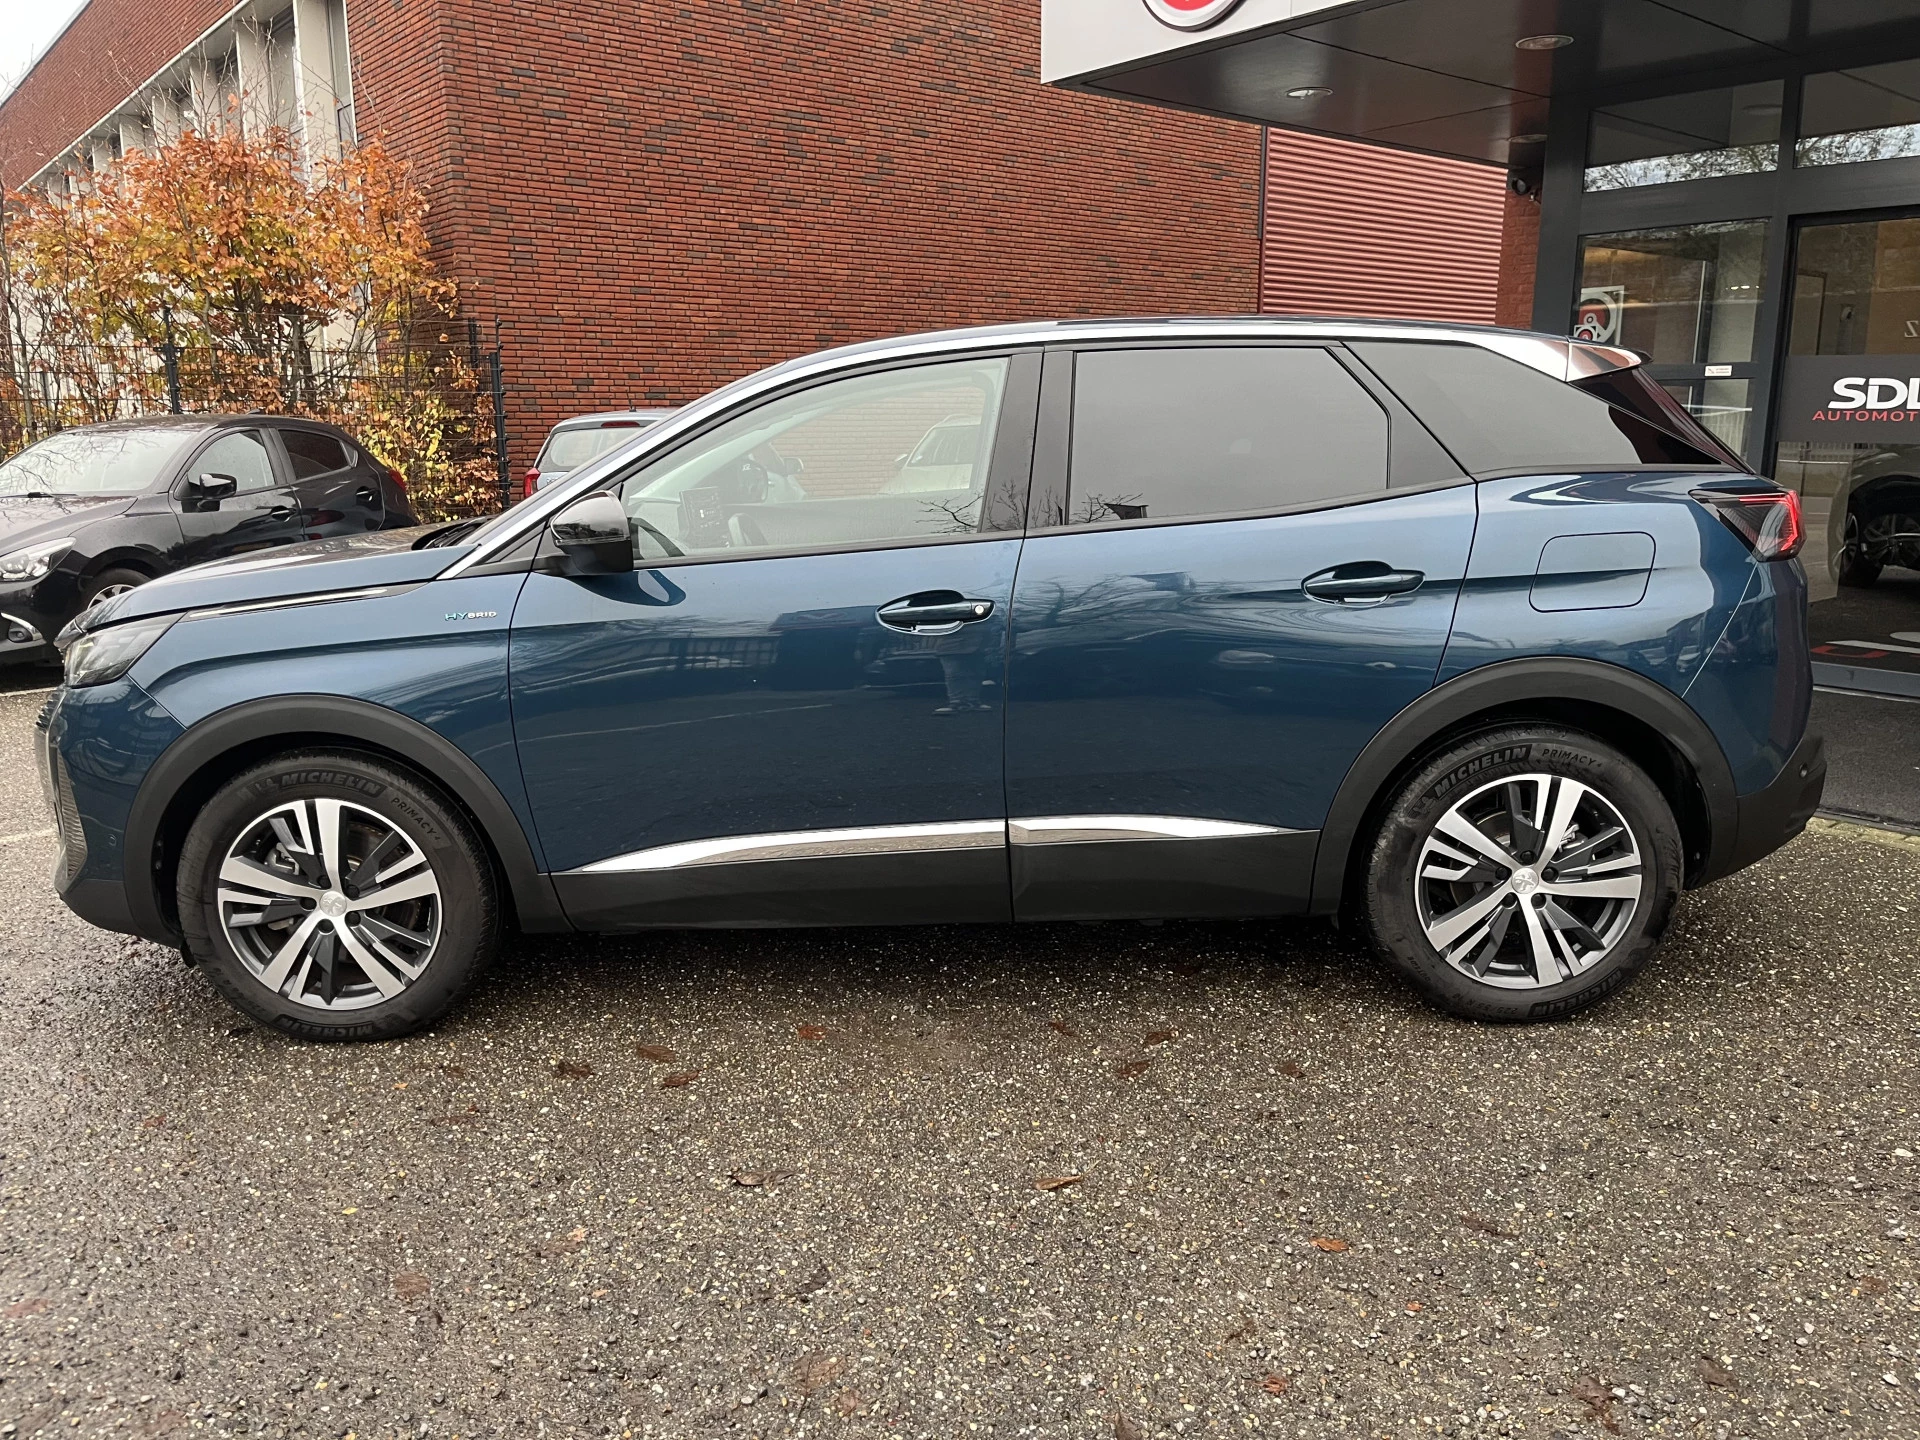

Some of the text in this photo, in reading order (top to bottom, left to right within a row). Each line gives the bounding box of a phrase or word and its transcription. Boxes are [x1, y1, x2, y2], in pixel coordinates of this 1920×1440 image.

[445, 611, 497, 621] HYBRID
[1542, 749, 1597, 767] PRIMACY
[281, 771, 381, 795] MICHELIN
[1435, 746, 1527, 798] MICHELIN
[391, 797, 436, 836] PRIMACY
